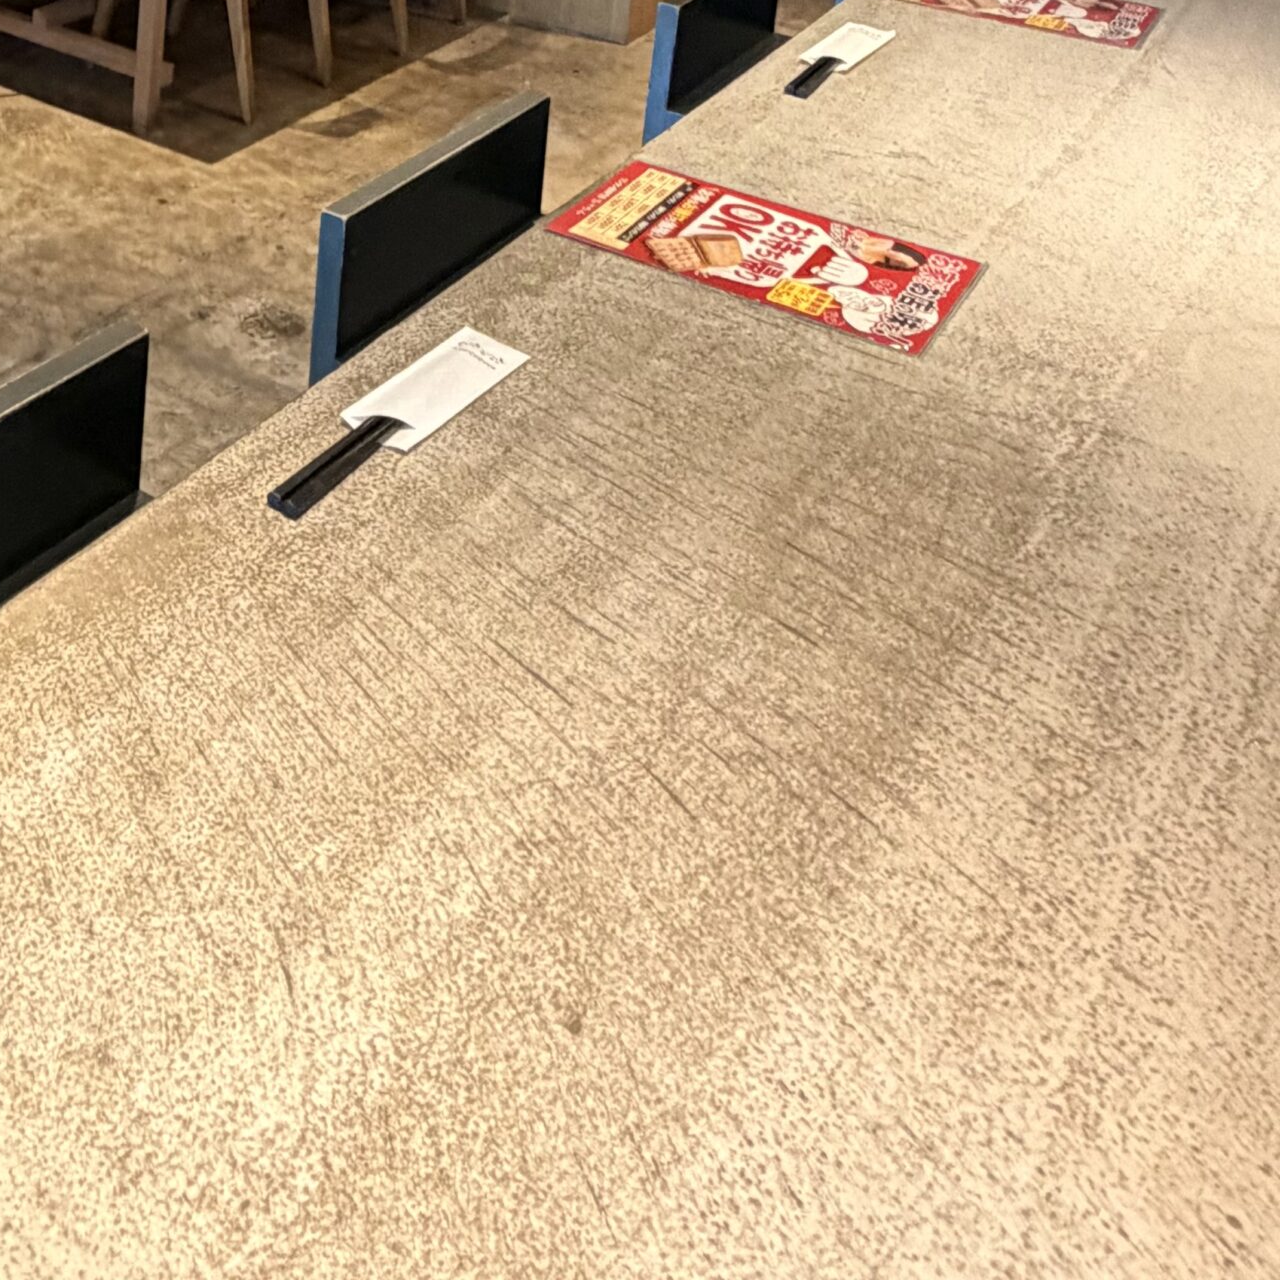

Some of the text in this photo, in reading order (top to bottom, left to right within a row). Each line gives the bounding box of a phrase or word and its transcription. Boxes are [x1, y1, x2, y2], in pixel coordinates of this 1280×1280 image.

[701, 202, 776, 242] OK
[734, 220, 820, 283] お持ち帰り
